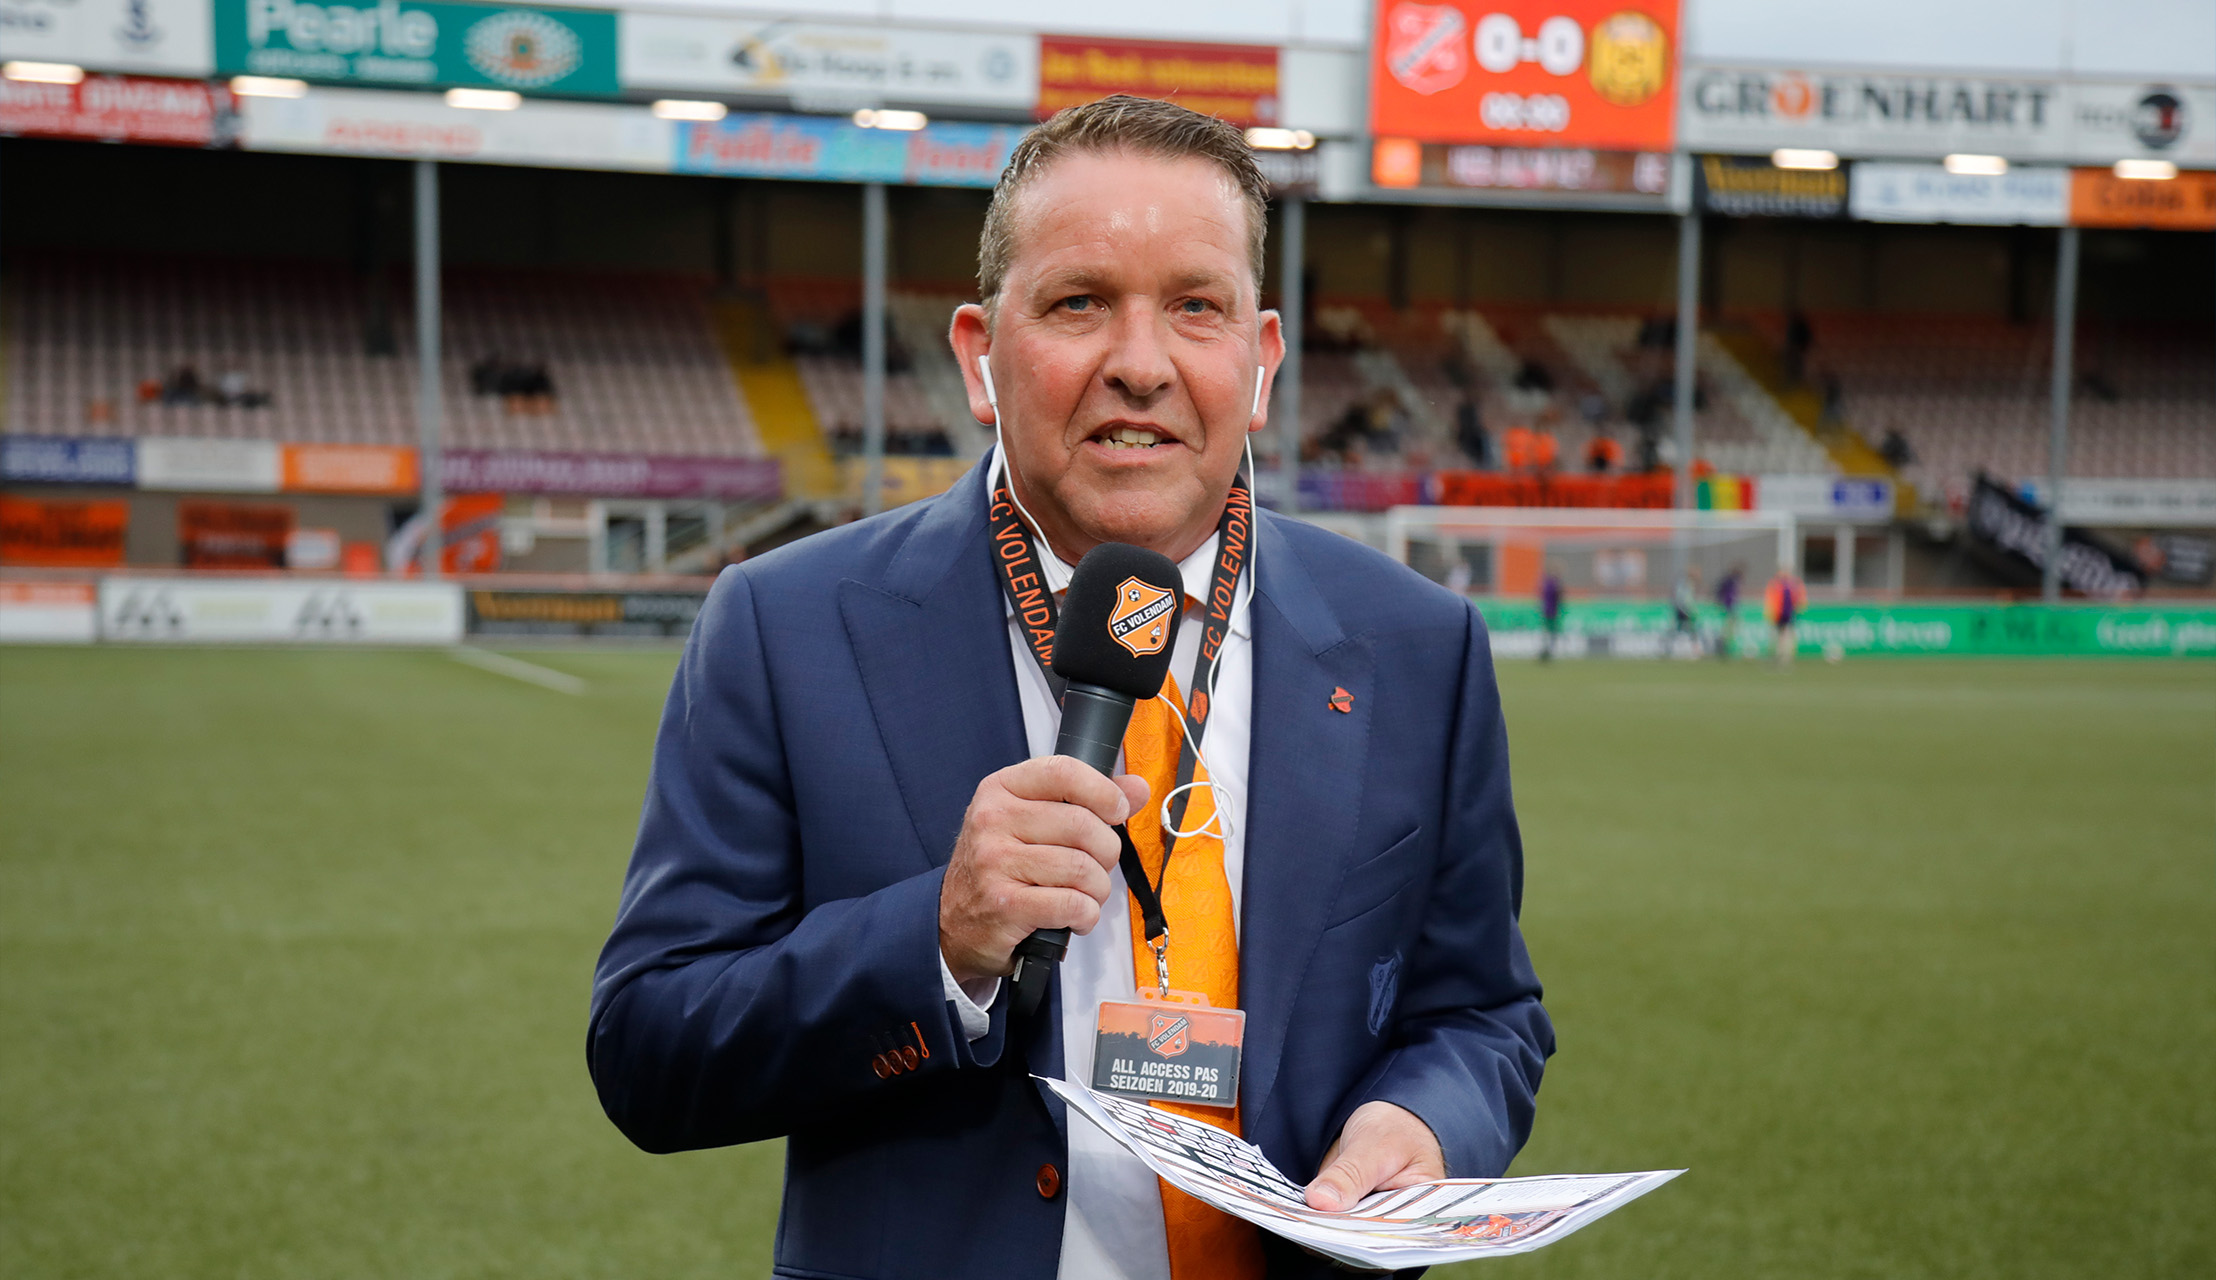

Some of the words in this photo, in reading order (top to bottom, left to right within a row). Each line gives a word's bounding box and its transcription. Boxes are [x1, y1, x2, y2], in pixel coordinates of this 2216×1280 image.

[1694, 78, 2052, 126] GROENHART
[990, 487, 1014, 522] FC
[1211, 487, 1250, 621] VOLENDAM
[1113, 622, 1128, 636] FC
[1127, 595, 1173, 628] VOLENDAM
[1203, 626, 1222, 661] FC
[1151, 1040, 1160, 1049] FC
[1158, 1019, 1188, 1042] VOLENDAM
[1110, 1075, 1164, 1093] SEIZOEN
[1167, 1080, 1218, 1099] 2019-20
[1112, 1058, 1136, 1075] ALL
[1140, 1061, 1190, 1079] ACCESS
[1194, 1066, 1219, 1082] PAS
